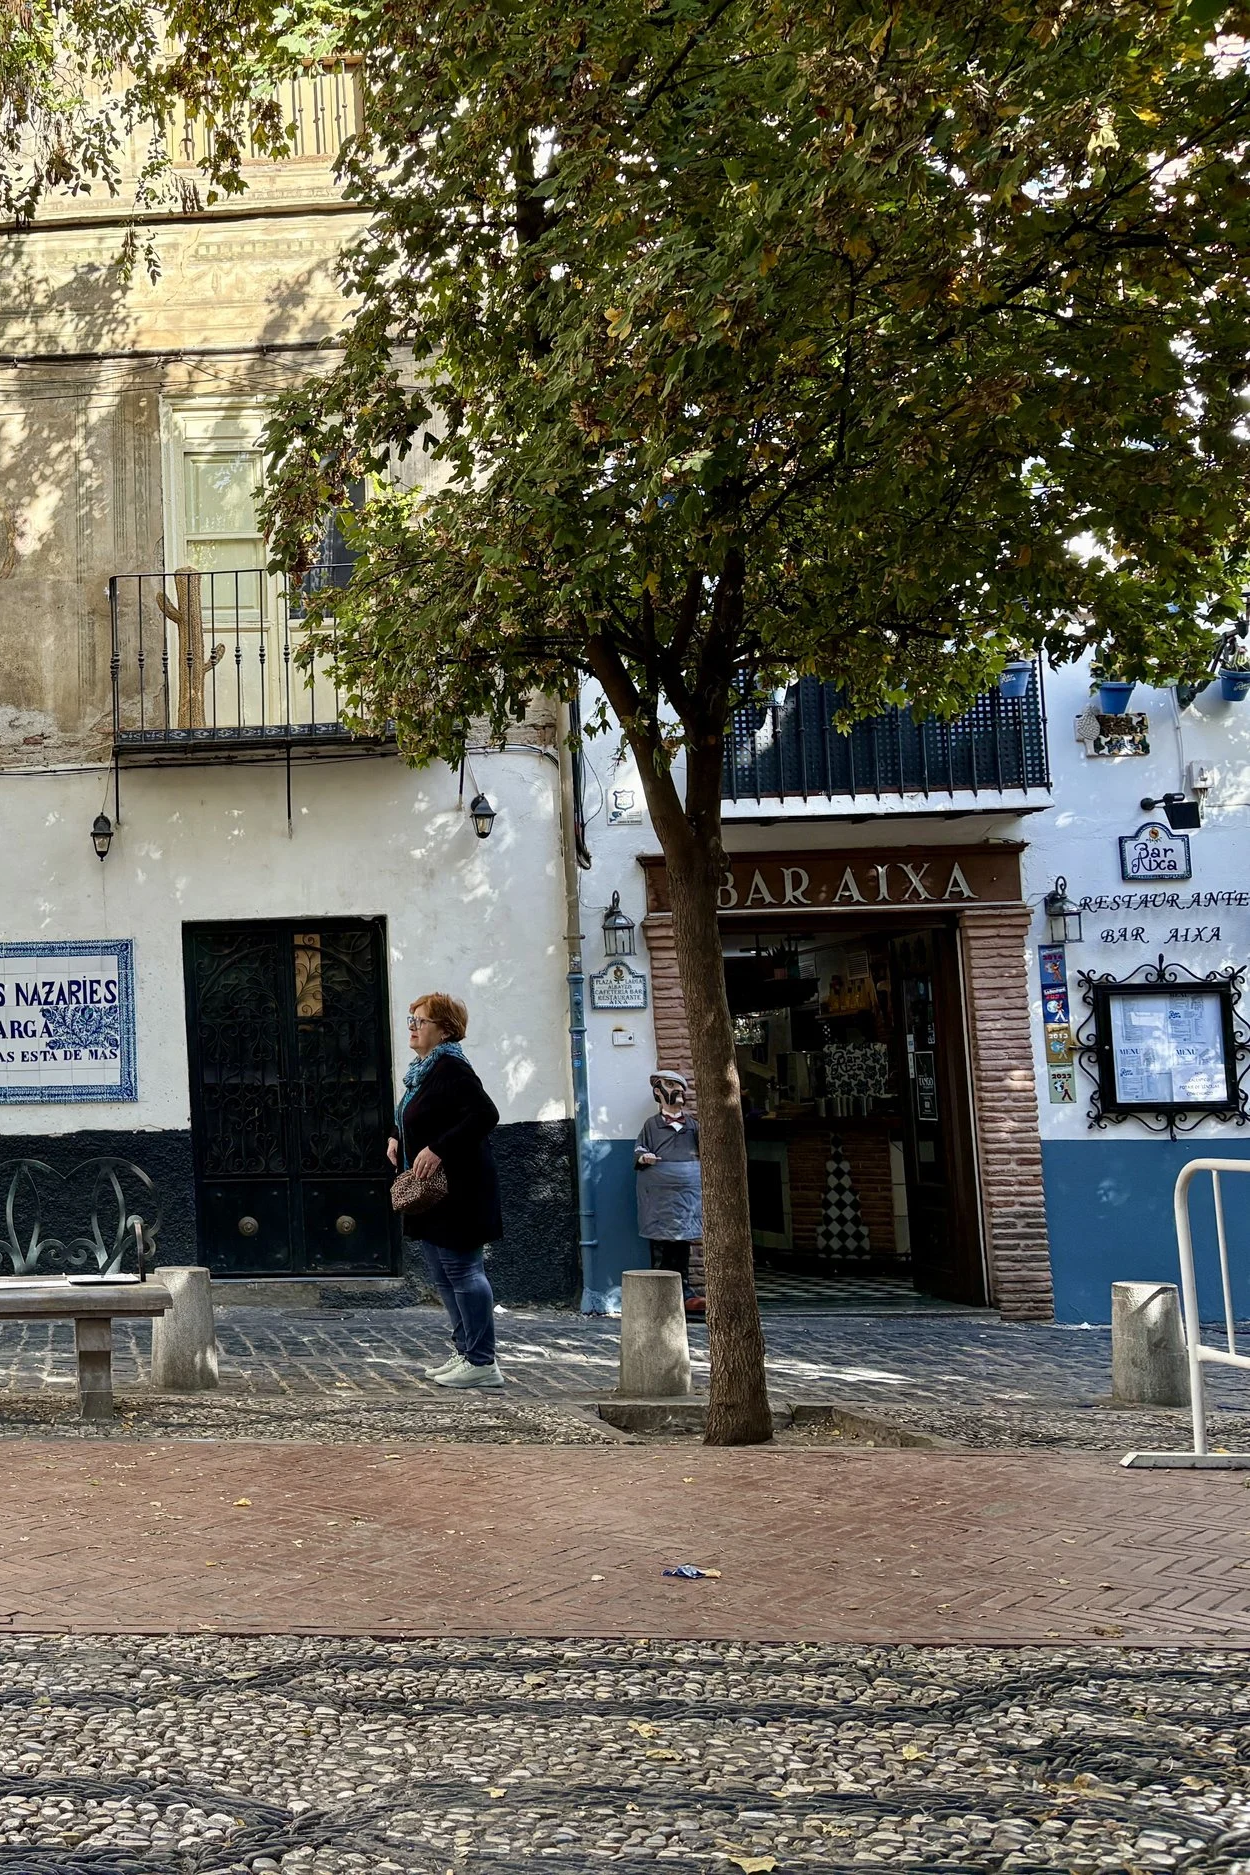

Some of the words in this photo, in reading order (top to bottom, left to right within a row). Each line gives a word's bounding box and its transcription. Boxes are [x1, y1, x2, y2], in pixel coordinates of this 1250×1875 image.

[1133, 842, 1174, 860] Bar
[1131, 851, 1178, 874] Aixa
[717, 867, 812, 908] BAR
[832, 862, 979, 903] AIXA
[1079, 890, 1250, 913] RESTAURANTE
[1100, 926, 1150, 944] BAR
[1163, 926, 1222, 945] AIXA
[21, 1050, 58, 1063] ESTA
[63, 1049, 83, 1061] DE
[88, 1048, 118, 1061] MAS
